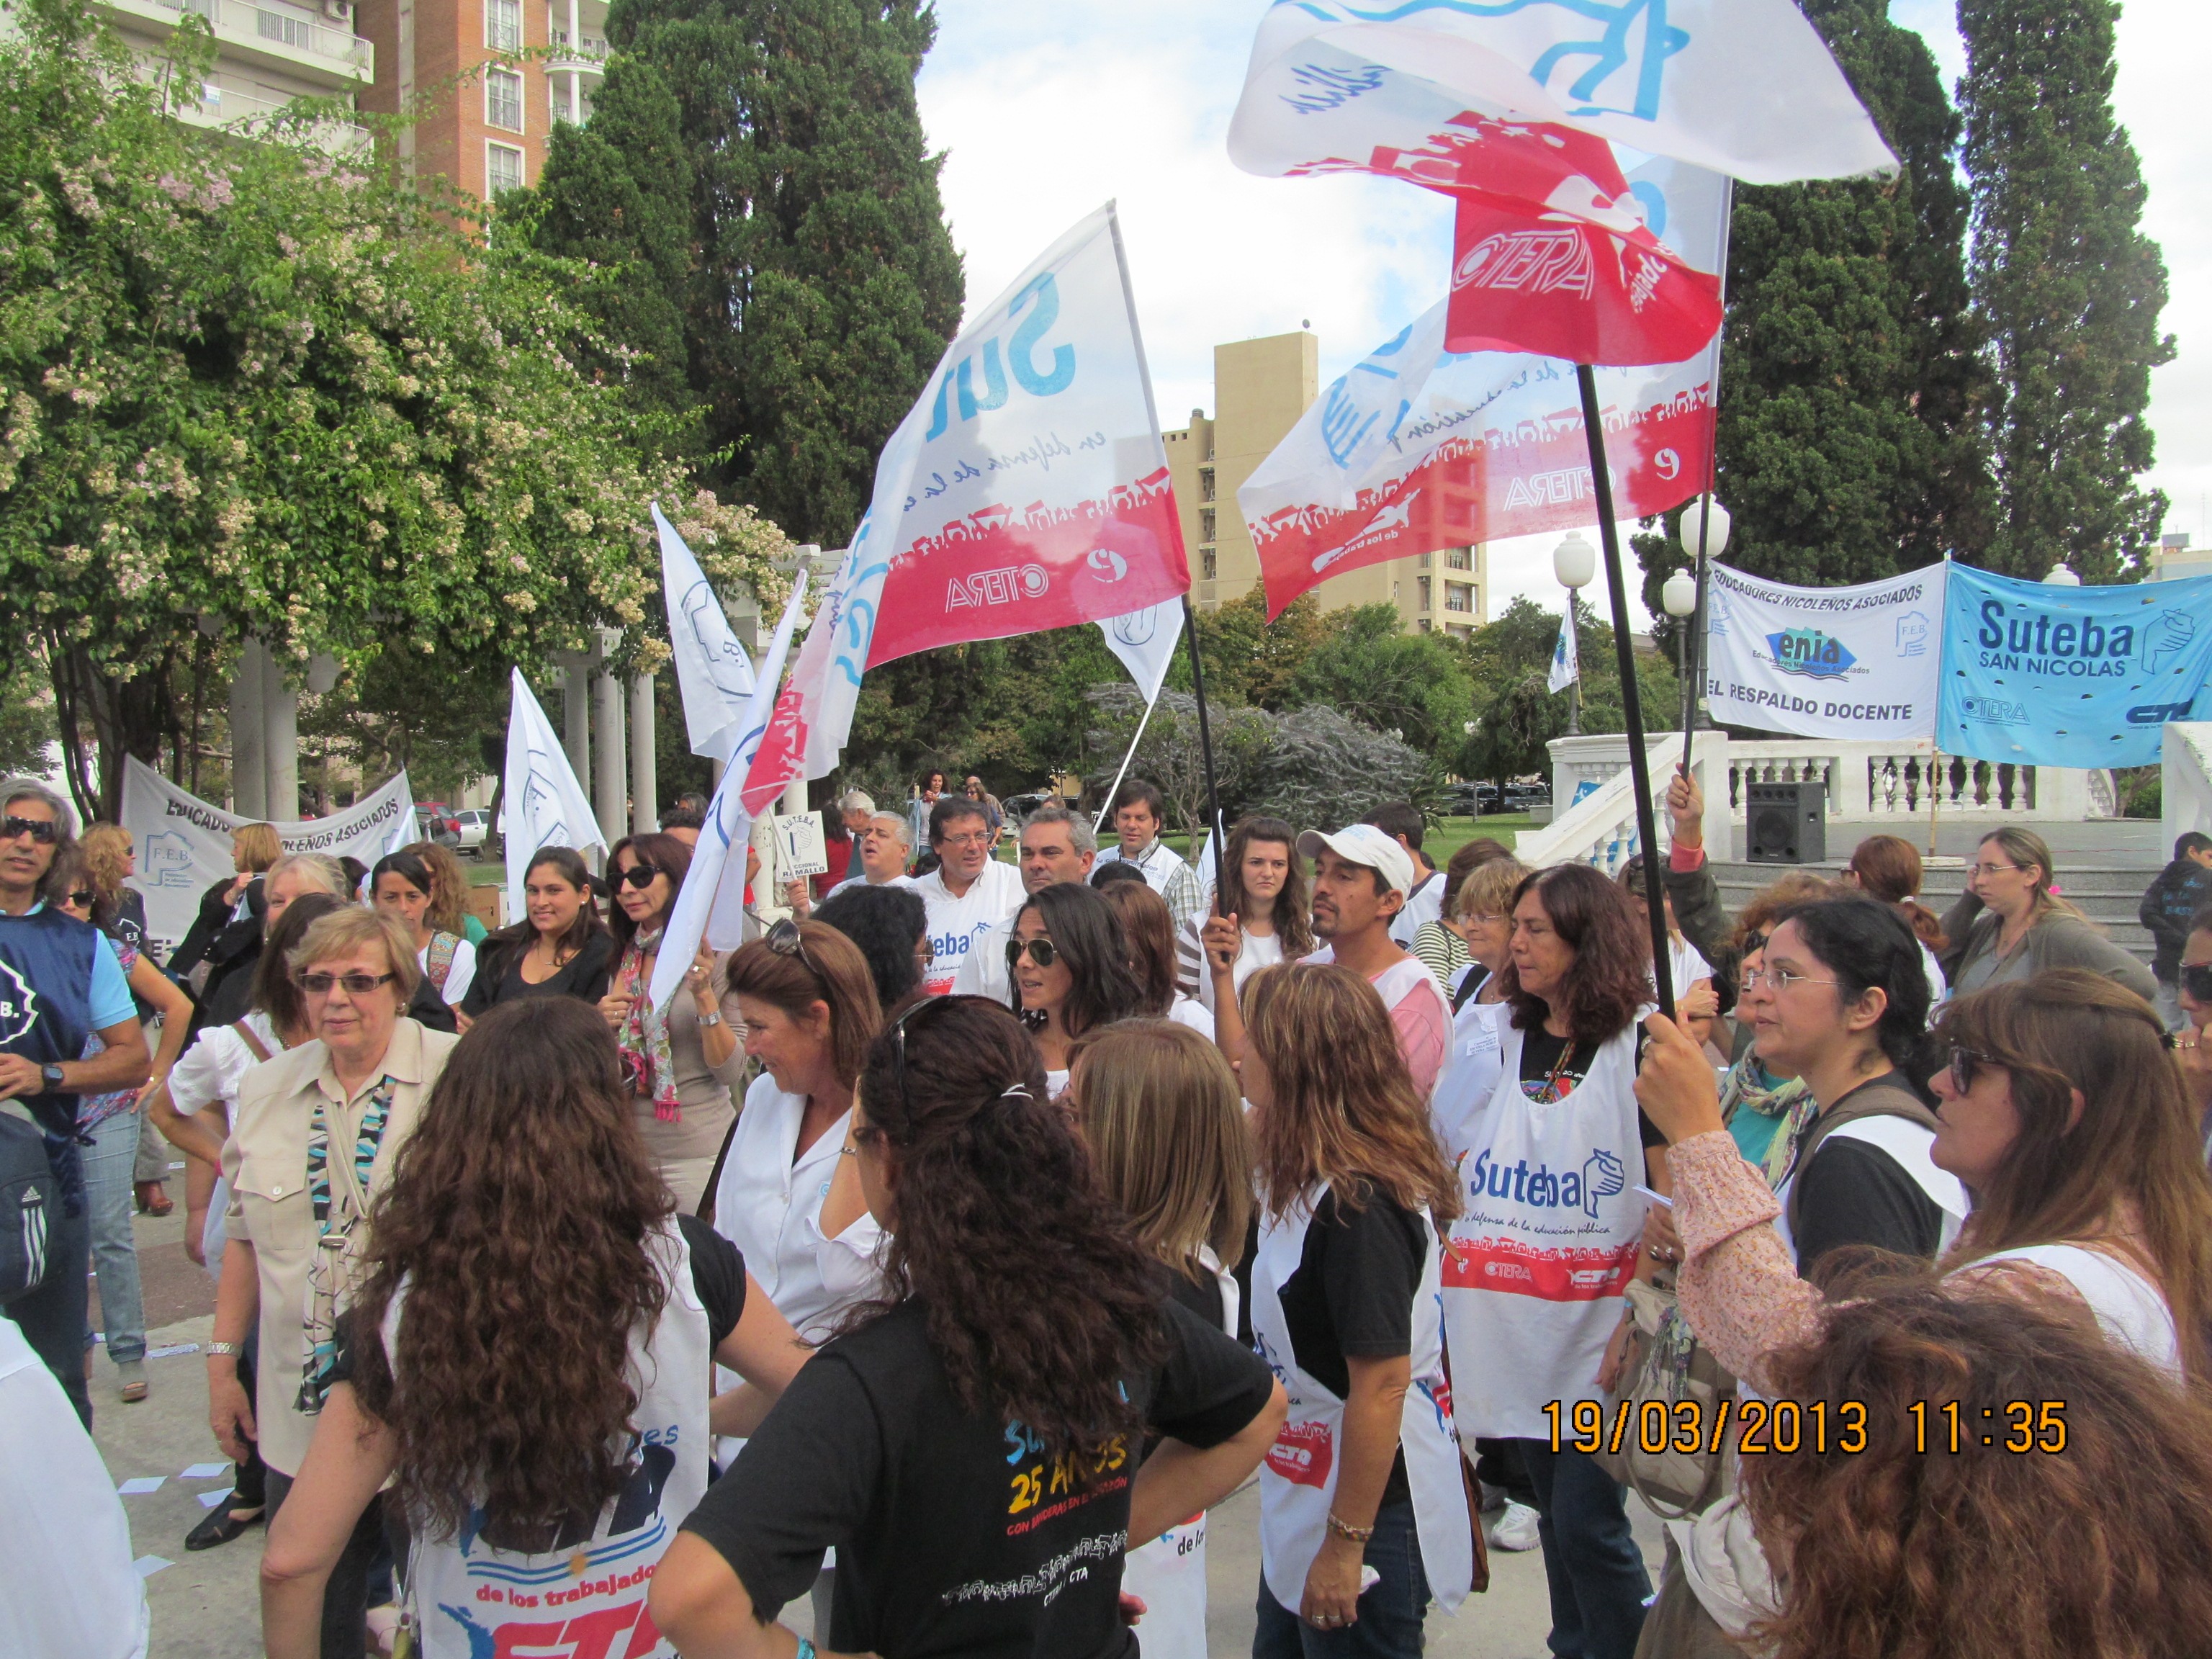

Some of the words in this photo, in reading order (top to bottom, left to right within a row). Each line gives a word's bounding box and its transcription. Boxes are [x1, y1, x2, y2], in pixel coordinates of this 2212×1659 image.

[1452, 228, 1594, 300] CTERA
[1714, 569, 1782, 604] EDUCADORES
[1781, 595, 1852, 612] NICOLEÑOS
[1852, 584, 1923, 611] ASOCIADOS
[1979, 599, 2135, 658] Suteba
[1779, 630, 1840, 664] enia
[1979, 651, 2019, 671] SAN
[2027, 658, 2126, 677] NICOLAS
[1730, 683, 1818, 714] RESPALDO
[1824, 702, 1912, 720] DOCENTE
[1961, 696, 2031, 723] CTERA
[335, 797, 399, 843] ASOCIADOS
[153, 848, 192, 861] F.E.B.
[786, 861, 820, 871] SCCIONAL
[1470, 1148, 1581, 1208] Suteba
[1471, 1211, 1506, 1226] defensa
[1507, 1217, 1519, 1228] de
[1520, 1220, 1531, 1232] la
[1534, 1224, 1576, 1236] educación
[1576, 1222, 1611, 1238] pública
[1484, 1261, 1533, 1282] CTERA
[1008, 1464, 1042, 1514] 25
[1006, 1520, 1030, 1536] CON
[1068, 1496, 1080, 1510] EN
[1177, 1536, 1193, 1557] de
[476, 1583, 504, 1603] de
[508, 1587, 539, 1609] los
[544, 1563, 658, 1606] trabajado
[1069, 1566, 1089, 1583] CTA
